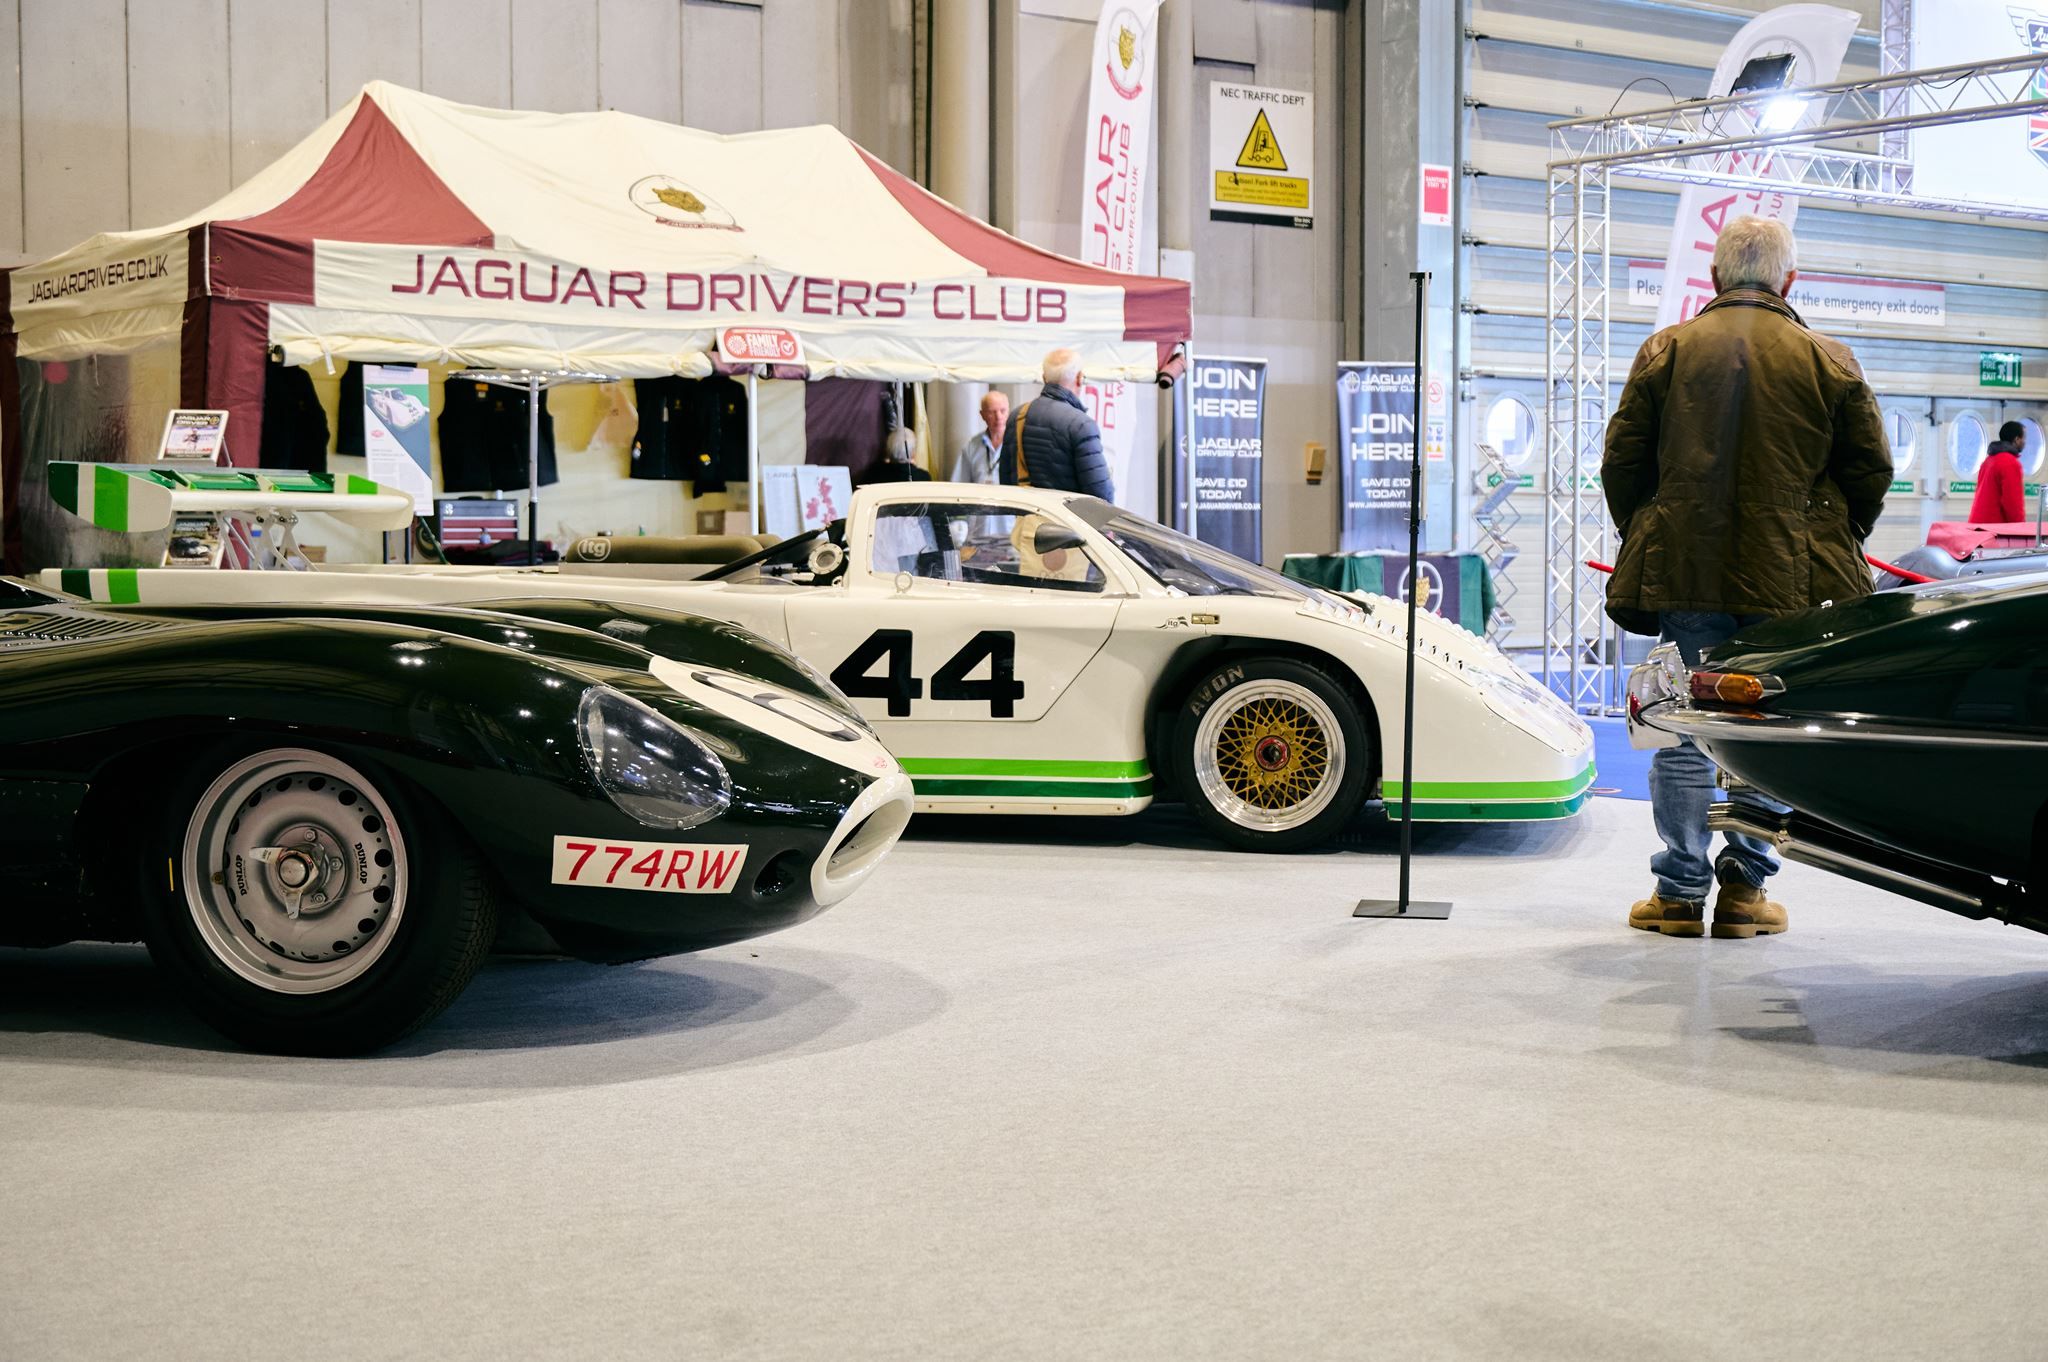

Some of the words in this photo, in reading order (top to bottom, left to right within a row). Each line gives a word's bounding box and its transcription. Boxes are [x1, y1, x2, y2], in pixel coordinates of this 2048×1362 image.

[1220, 87, 1240, 98] NEC
[1243, 89, 1280, 103] TRAFFIC
[1282, 94, 1306, 106] DEPT
[1114, 123, 1130, 232] CLUB
[1228, 176, 1253, 184] Ction!
[28, 254, 168, 304] JAGUARDRIVER.CO.UK
[391, 254, 647, 309] JAGUAR
[666, 272, 917, 318] DRIVERS'
[932, 284, 1068, 324] CLUB
[1637, 279, 1663, 296] Plea
[1788, 290, 1798, 305] of
[1801, 291, 1820, 306] the
[1824, 297, 1883, 315] emergency
[1887, 299, 1906, 313] exit
[1910, 300, 1940, 315] doors
[746, 333, 779, 347] FAMILY
[1982, 371, 1996, 380] EXIT
[1351, 413, 1415, 434] JOIN
[1197, 437, 1261, 449] JAGUAR
[1351, 442, 1414, 461] HERE
[1238, 450, 1261, 458] CLUB
[1195, 477, 1225, 487] SAVE
[1227, 478, 1247, 488] £10
[1361, 477, 1390, 487] SAVE
[1392, 478, 1411, 487] £10
[1200, 489, 1242, 499] TODAY!
[1365, 489, 1406, 498] TODAY!
[581, 540, 606, 557] itg
[830, 629, 1025, 718] 44
[1191, 665, 1245, 717] AVON
[354, 842, 368, 884] DUNLOP
[566, 842, 741, 889] 774RW
[235, 854, 248, 896] DUNLOP
